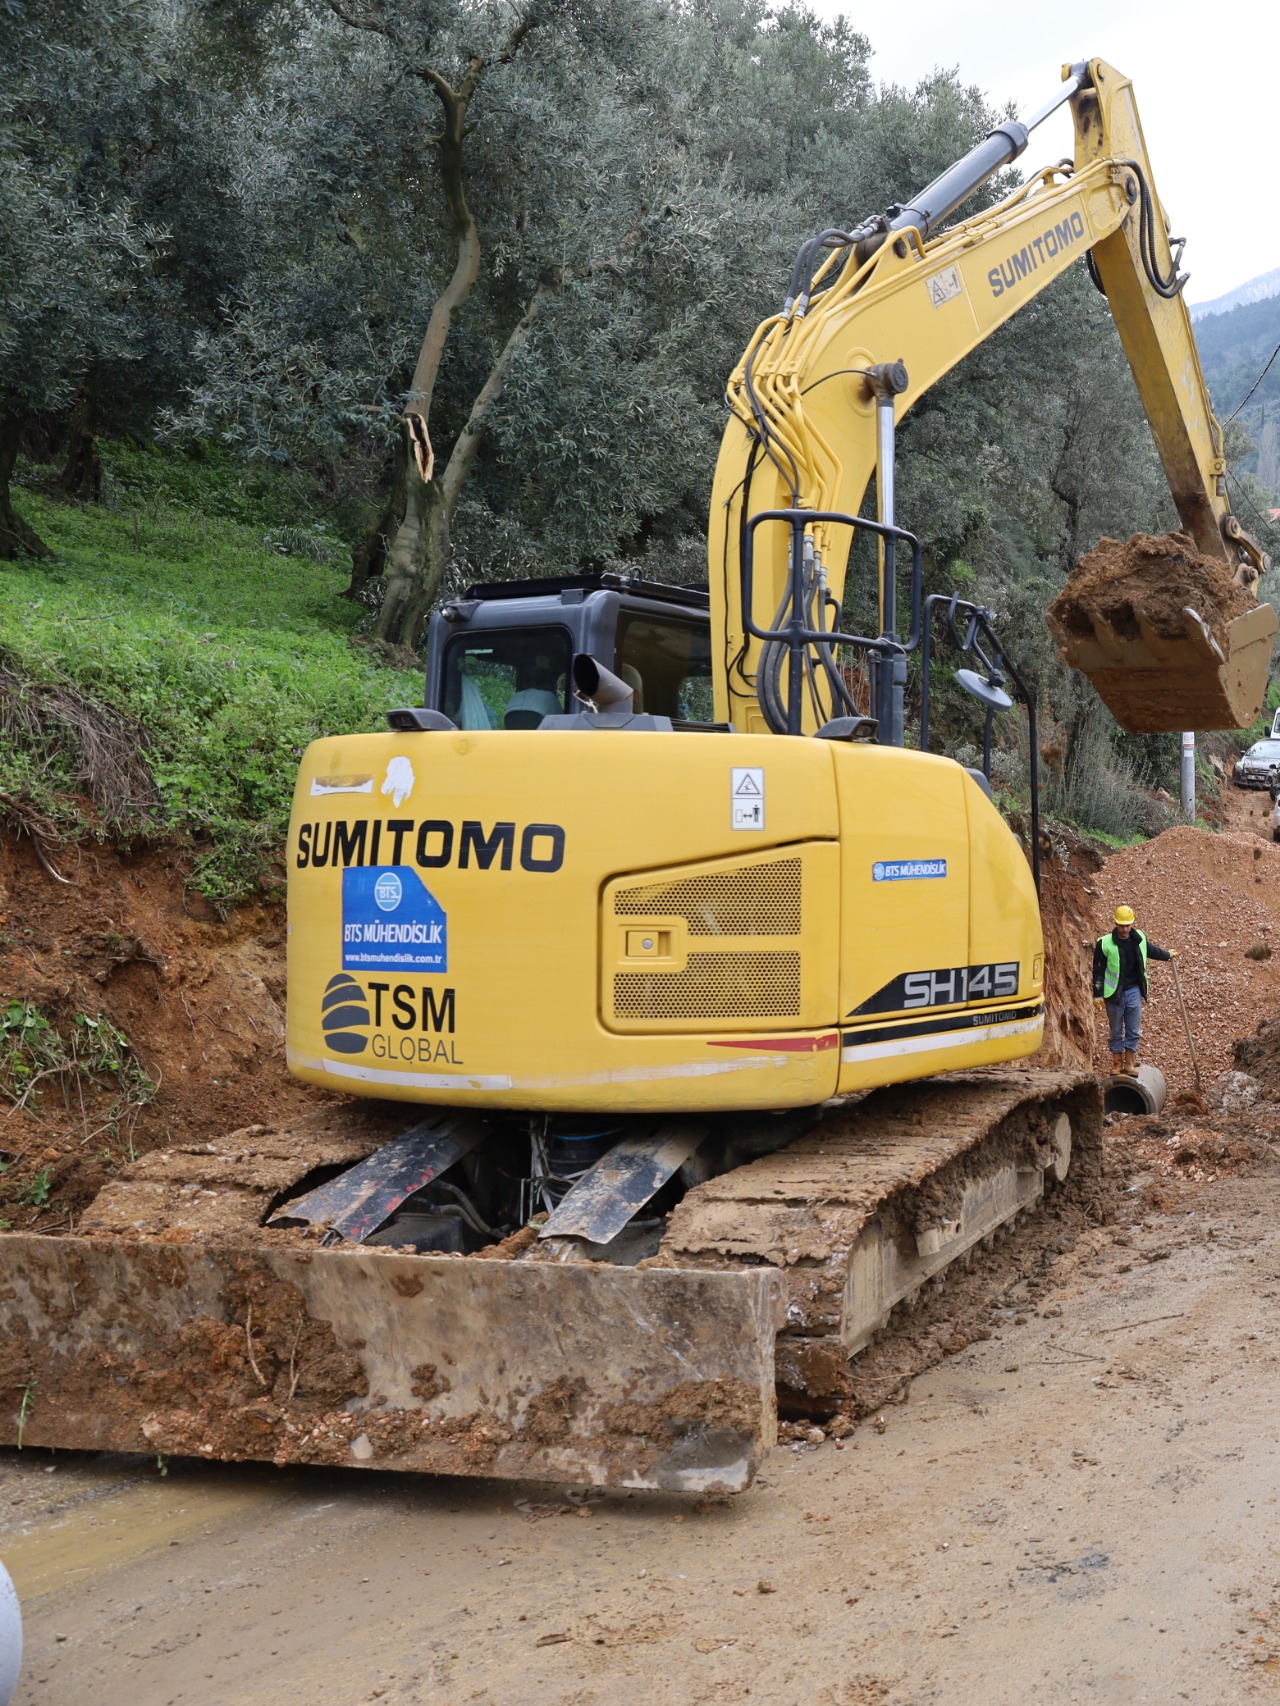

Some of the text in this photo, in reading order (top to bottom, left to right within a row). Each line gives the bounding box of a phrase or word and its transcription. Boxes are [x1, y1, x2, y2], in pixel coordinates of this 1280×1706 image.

[987, 211, 1085, 298] SUMITOMO
[296, 819, 566, 873] SUMITOMO
[885, 865, 899, 877] BTS
[900, 861, 946, 876] MÜHENDİSLİK
[379, 886, 396, 899] BTS
[344, 919, 443, 944] BTS MÜHENDİSLİK
[344, 952, 442, 964] www.btsmuhendislik.com.tr
[368, 982, 456, 1034] TSM
[972, 1010, 1017, 1026] SUMITOMO
[371, 1034, 464, 1065] GLOBAL
